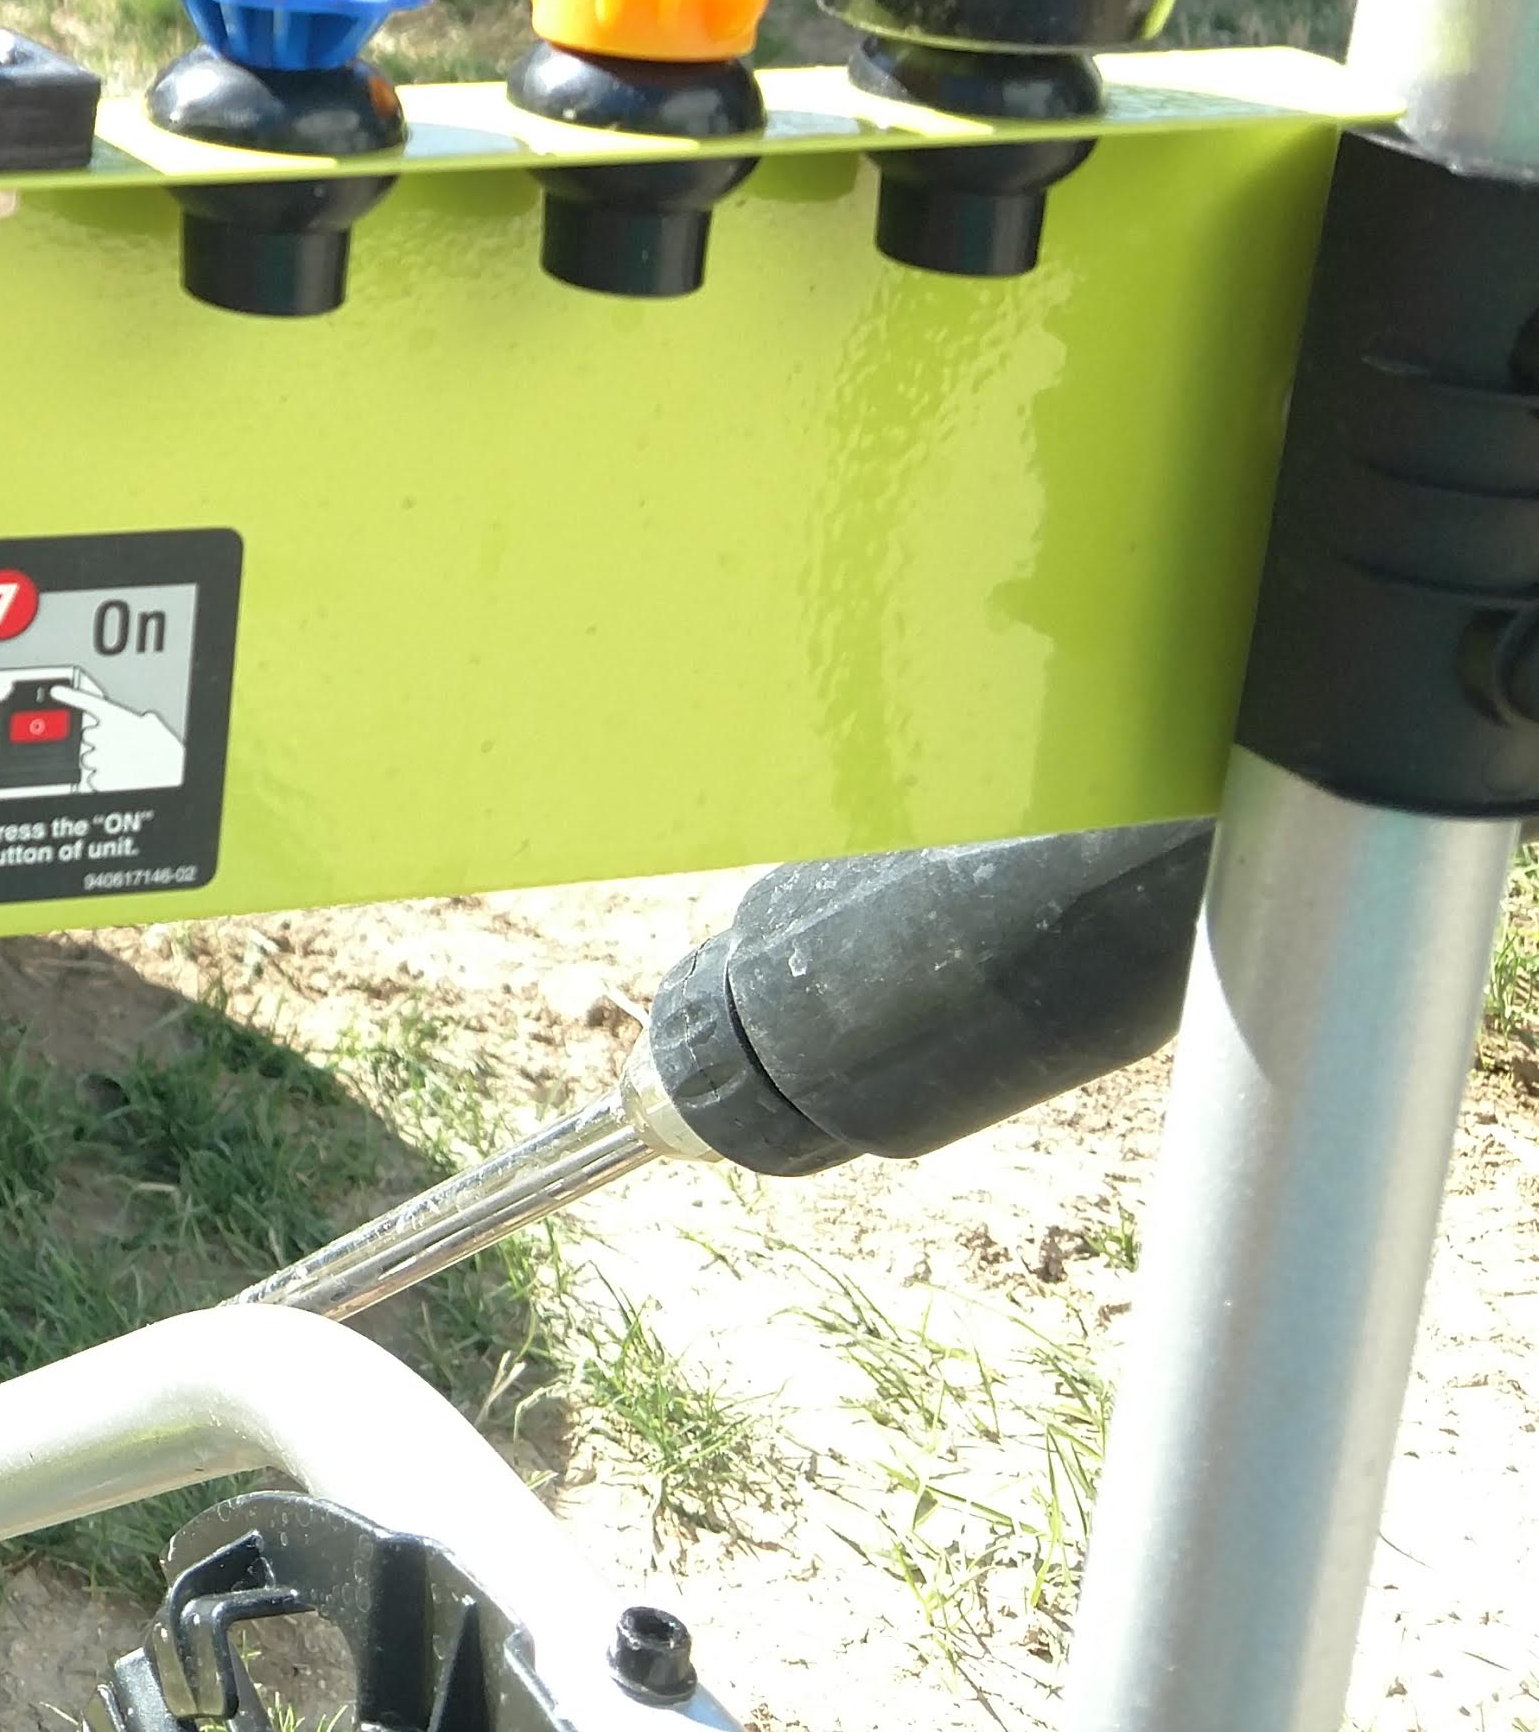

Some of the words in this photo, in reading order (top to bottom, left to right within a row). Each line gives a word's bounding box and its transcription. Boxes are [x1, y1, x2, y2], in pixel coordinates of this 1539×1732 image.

[92, 598, 166, 655] On
[51, 815, 88, 839] the
[59, 840, 83, 863] of
[88, 837, 139, 860] unit.
